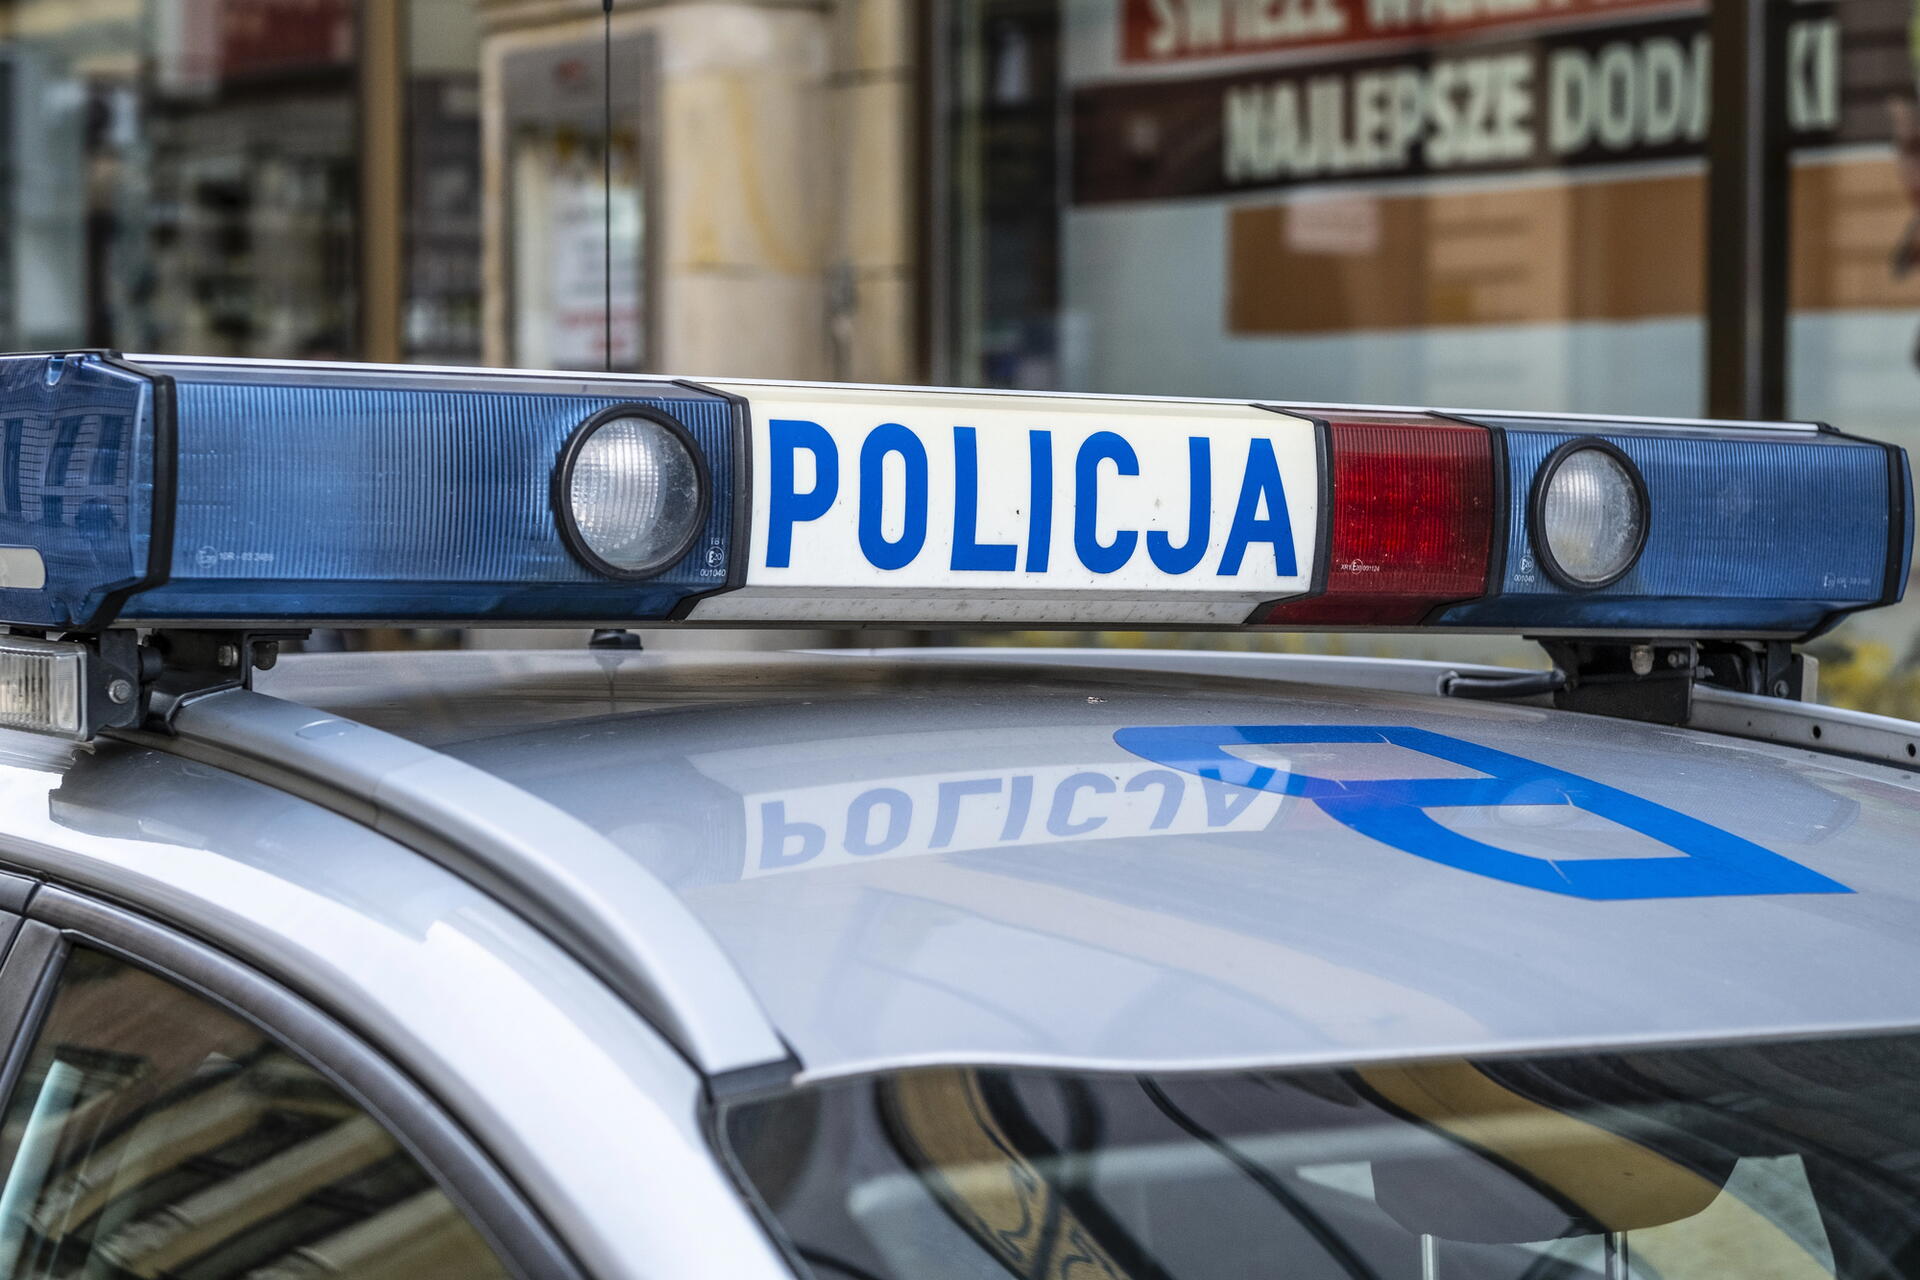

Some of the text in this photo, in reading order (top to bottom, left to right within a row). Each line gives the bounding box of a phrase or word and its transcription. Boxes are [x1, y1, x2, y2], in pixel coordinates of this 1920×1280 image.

[1224, 18, 1840, 182] NAJLEPSZE DODI
[766, 418, 1299, 577] POLICJA
